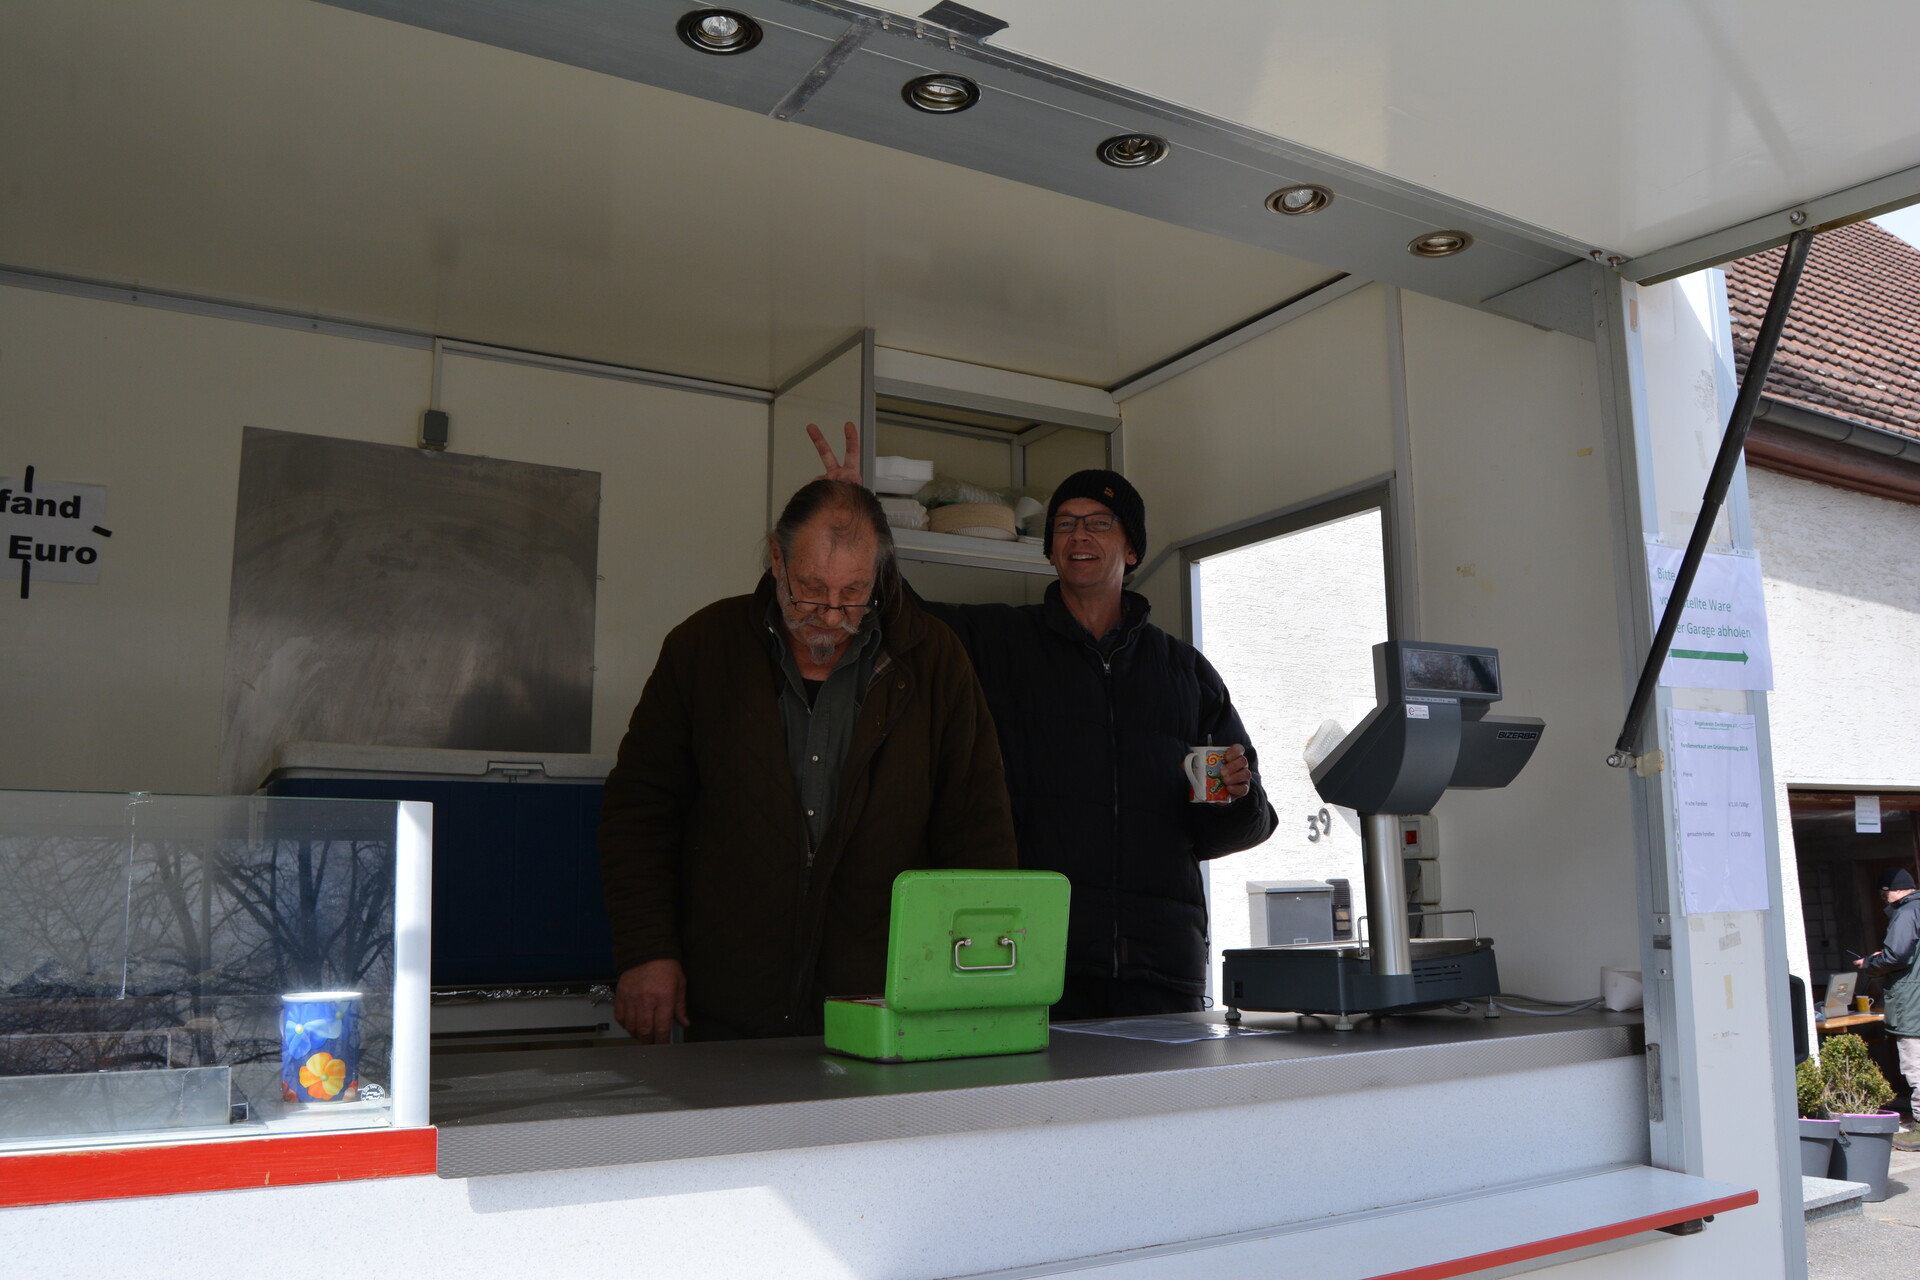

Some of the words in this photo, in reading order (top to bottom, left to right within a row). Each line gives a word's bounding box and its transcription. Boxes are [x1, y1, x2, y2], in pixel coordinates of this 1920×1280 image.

[0, 488, 81, 519] fand
[9, 534, 97, 565] Euro
[1657, 567, 1676, 581] Bitte
[1708, 599, 1732, 613] Ware
[1686, 622, 1716, 639] Garage
[1717, 624, 1752, 638] abholen
[1498, 731, 1537, 740] BIZERBA
[1307, 808, 1331, 842] 39
